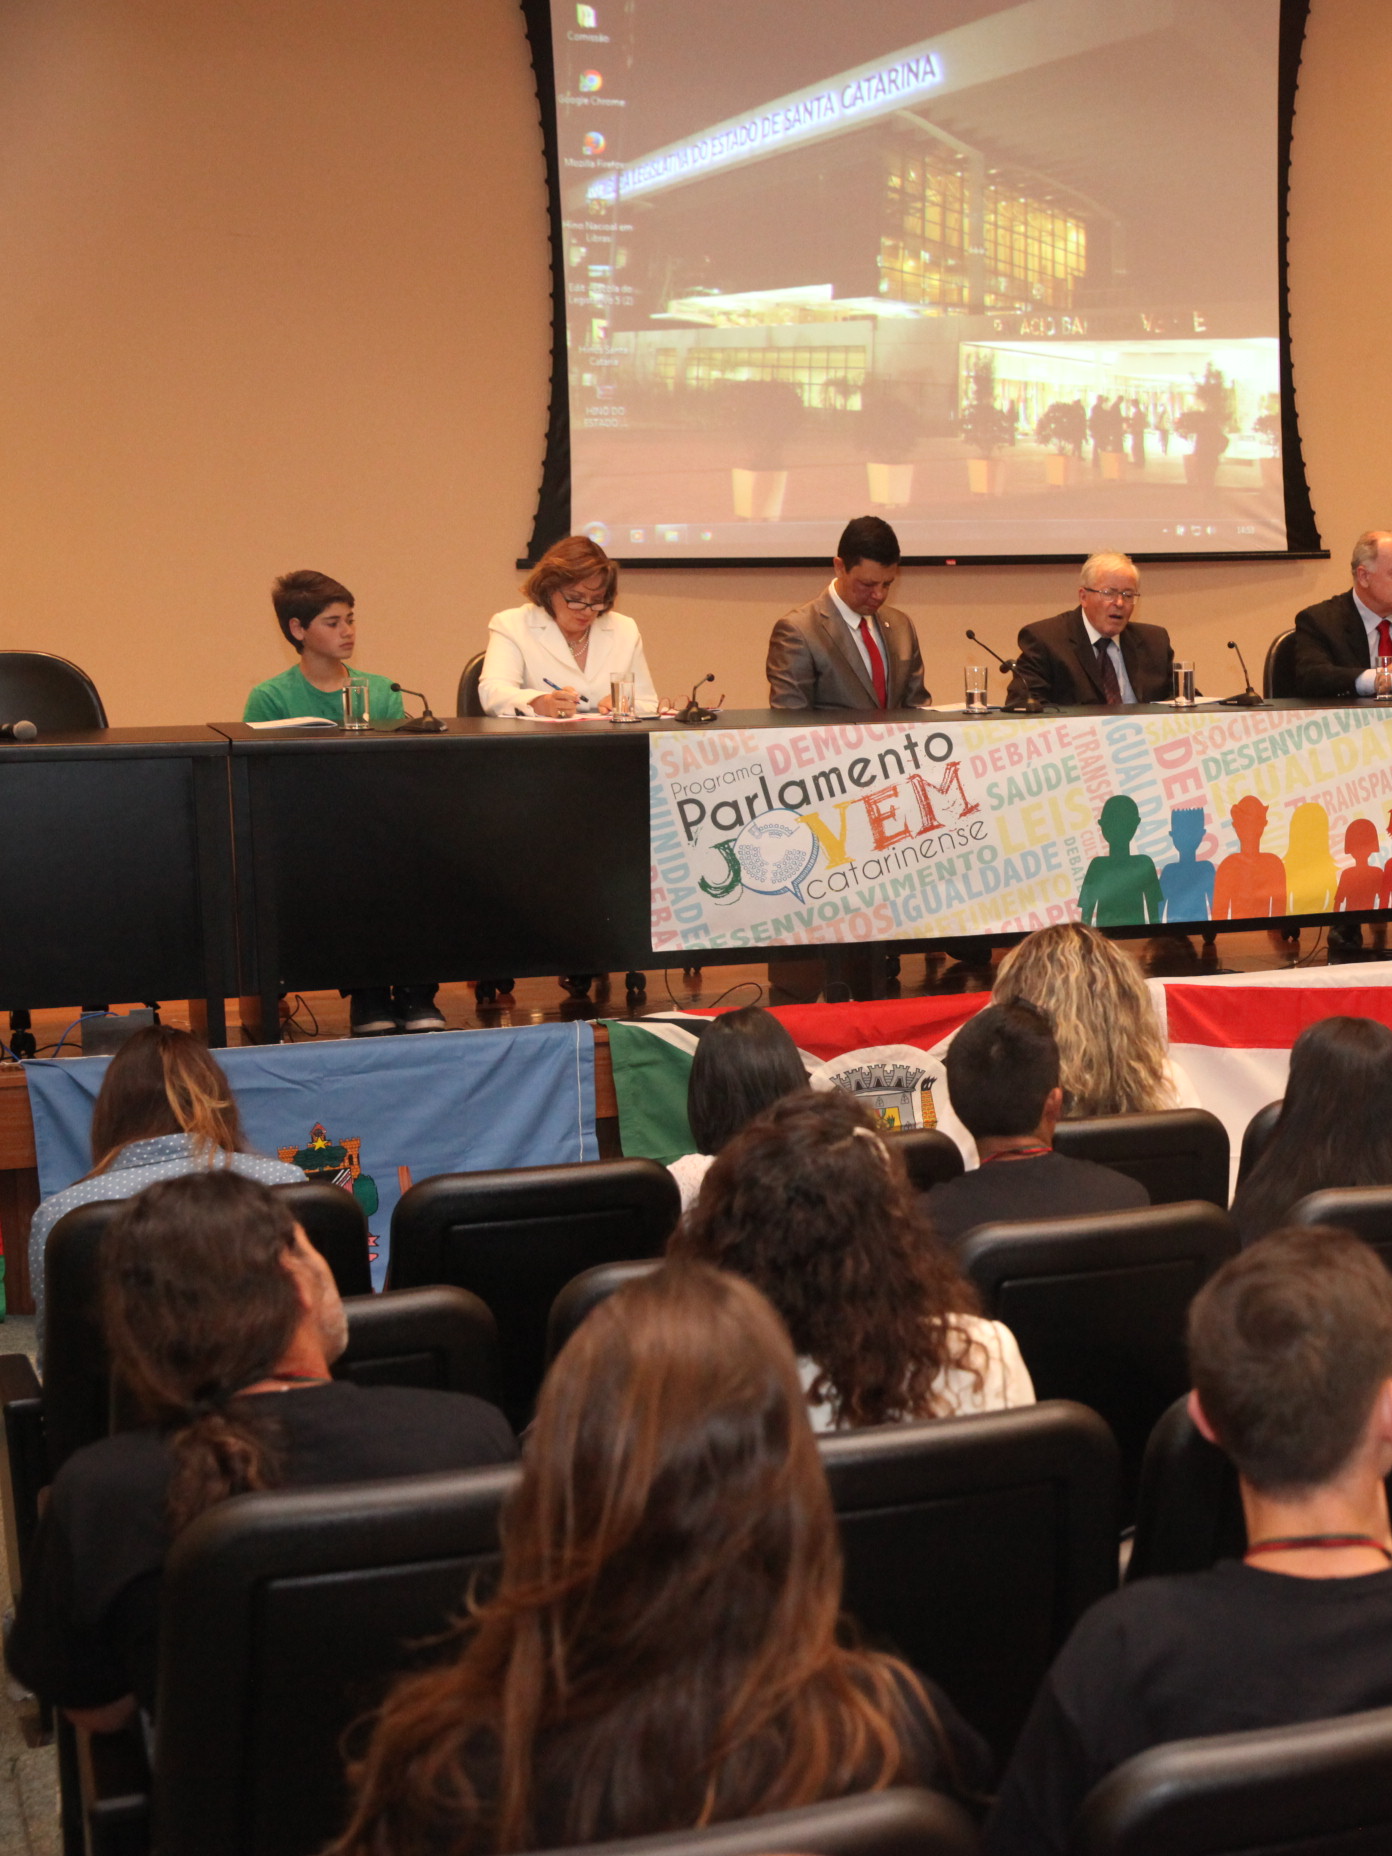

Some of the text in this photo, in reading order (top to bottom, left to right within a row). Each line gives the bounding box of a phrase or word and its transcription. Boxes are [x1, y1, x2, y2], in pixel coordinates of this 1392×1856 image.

[711, 121, 758, 155] ESTADO
[762, 112, 781, 138] DE
[784, 92, 836, 131] SANTA
[840, 53, 937, 109] CATARINA
[670, 763, 764, 800] Programa
[676, 732, 954, 842] Parlamento
[969, 724, 1073, 780] DEBATE
[986, 754, 1081, 812] SAÚDE
[996, 787, 1093, 857] LEIS
[806, 820, 988, 900] catarinense
[889, 841, 1063, 928] IGUALDADE
